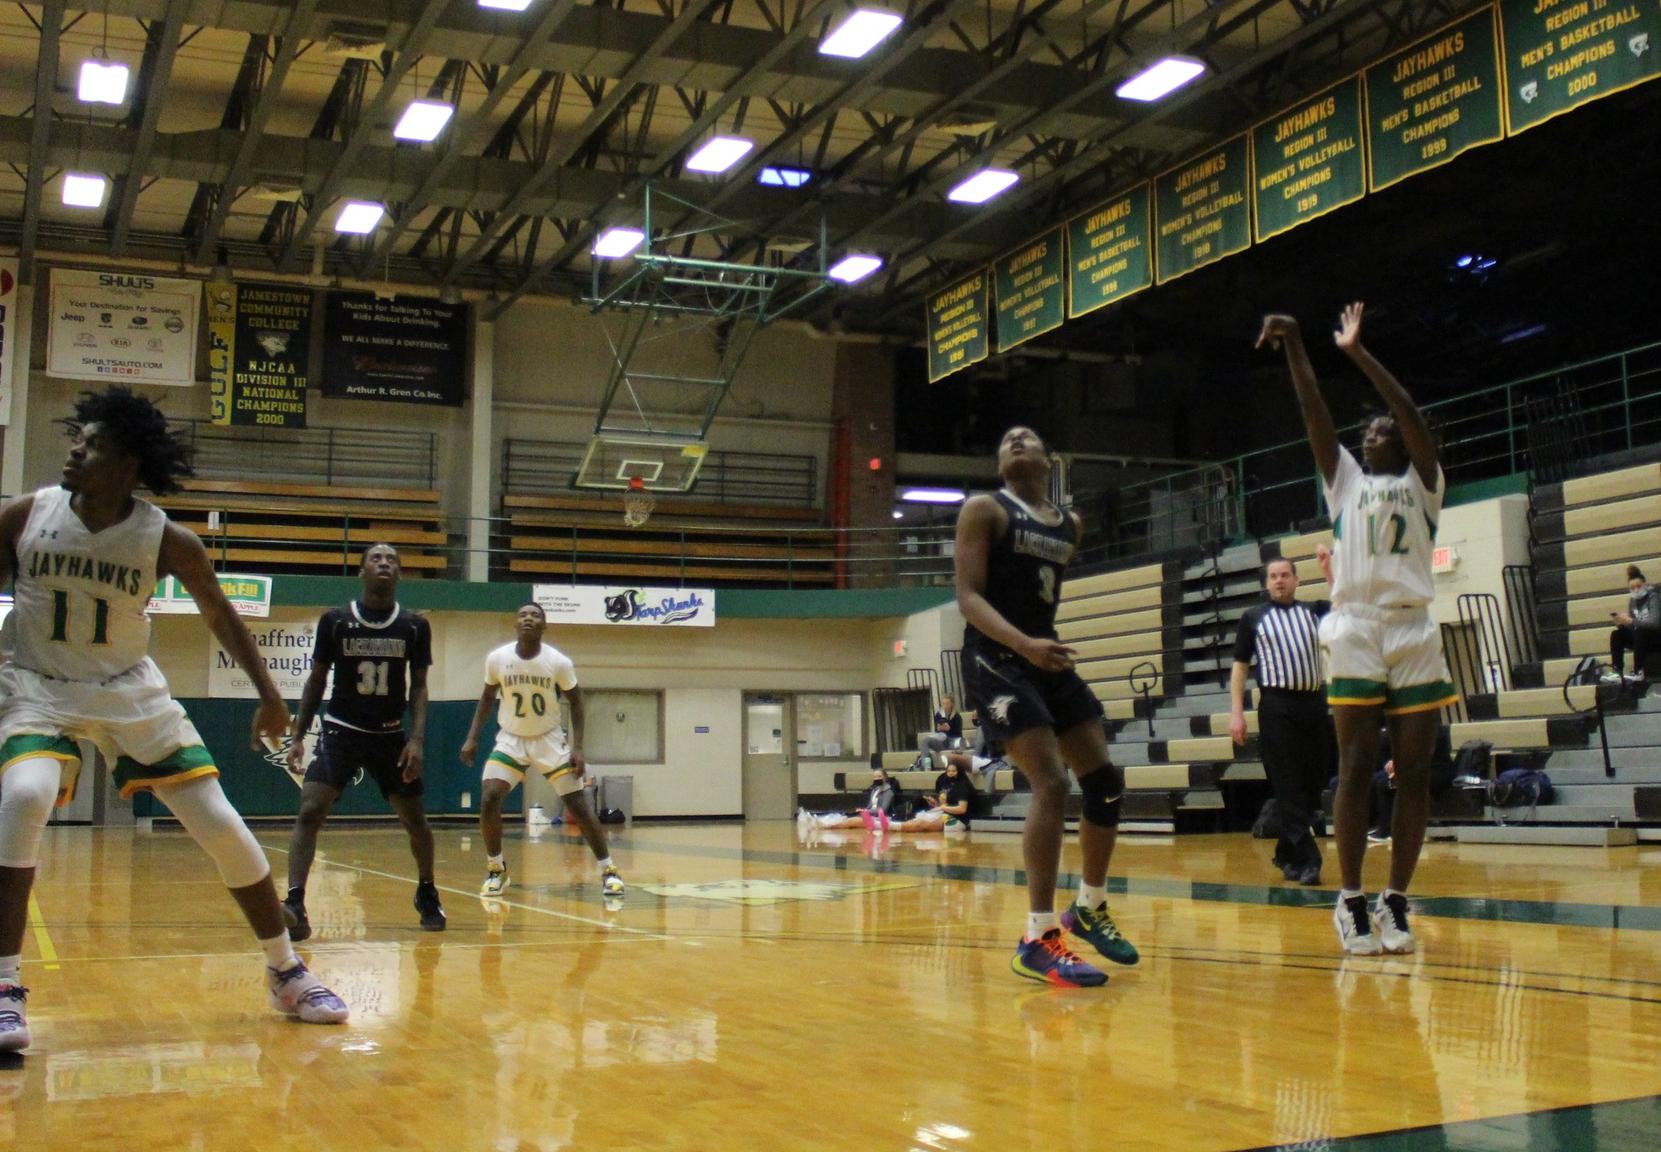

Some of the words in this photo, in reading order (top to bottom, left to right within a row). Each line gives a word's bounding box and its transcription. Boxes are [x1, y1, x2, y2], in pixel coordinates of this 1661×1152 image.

[1546, 2, 1588, 32] REGION
[1521, 41, 1554, 69] MEN'S
[1560, 5, 1640, 50] BASKETBALL
[1393, 32, 1464, 82] JAYHAWKS
[1547, 39, 1616, 81] CHAMPIONS
[1403, 72, 1440, 100] REGION
[1443, 64, 1456, 81] III
[1568, 72, 1597, 97] 2000
[1382, 108, 1409, 133] MEN'S
[1414, 76, 1482, 117] BASKETBALL
[1275, 95, 1336, 143] JAYHAWKS
[1403, 108, 1460, 144] CHAMPIONS
[1284, 132, 1314, 159] REGION
[1317, 127, 1327, 143] III
[1422, 138, 1447, 160] 1999
[1175, 153, 1226, 193] JAYHAWKS
[1260, 163, 1296, 192] WOMEN'S
[1299, 136, 1356, 172] VOLLEYBALL
[1182, 186, 1208, 208] REGION
[1210, 181, 1220, 195] III
[1284, 166, 1332, 200] CHAMPIONS
[1085, 199, 1131, 235] JAYHAWKS
[1161, 213, 1193, 237] WOMEN'S
[1195, 191, 1244, 220] VOLLEYBALL
[1091, 229, 1114, 249] REGION
[1181, 218, 1222, 246] CHAMPIONS
[1009, 241, 1047, 275] JAYHAWKS
[1098, 236, 1141, 263] BASKETBALL
[1091, 259, 1128, 284] CHAMPIONS
[240, 289, 311, 305] JAMESTOWN
[933, 275, 982, 313] JAYHAWKS
[60, 312, 85, 323] Jeep
[69, 300, 88, 310] Your
[90, 301, 135, 313] Destination
[136, 305, 148, 313] for
[150, 306, 181, 316] Savings
[240, 303, 310, 318] COMMUNITY
[342, 301, 373, 311] Thanks
[375, 304, 388, 312] for
[434, 310, 453, 318] Your
[352, 312, 372, 321] Kids
[374, 314, 400, 324] About
[940, 304, 965, 324] REGION
[248, 317, 300, 331] COLLEGE
[341, 335, 353, 343] WE
[355, 336, 370, 344] ALL
[371, 337, 394, 346] MAKE
[938, 328, 978, 354] CHAMPIONS
[82, 357, 163, 369] SHULTSAUTO.COM
[209, 331, 229, 420] GOLF
[248, 360, 296, 374] NJCAA
[236, 373, 287, 387] DIVISION
[293, 377, 307, 388] III
[242, 386, 299, 400] NATIONAL
[346, 386, 377, 395] Arthur
[379, 388, 388, 396] R.
[389, 388, 411, 398] Gren
[237, 399, 304, 414] CHAMPIONS
[256, 413, 285, 425] 2000
[1368, 513, 1410, 557] 12
[29, 551, 142, 596] JAYHAWKS
[51, 588, 112, 647] 11
[357, 661, 389, 696] 31
[503, 673, 552, 689] JAYHAWKS
[512, 692, 546, 718] 20
